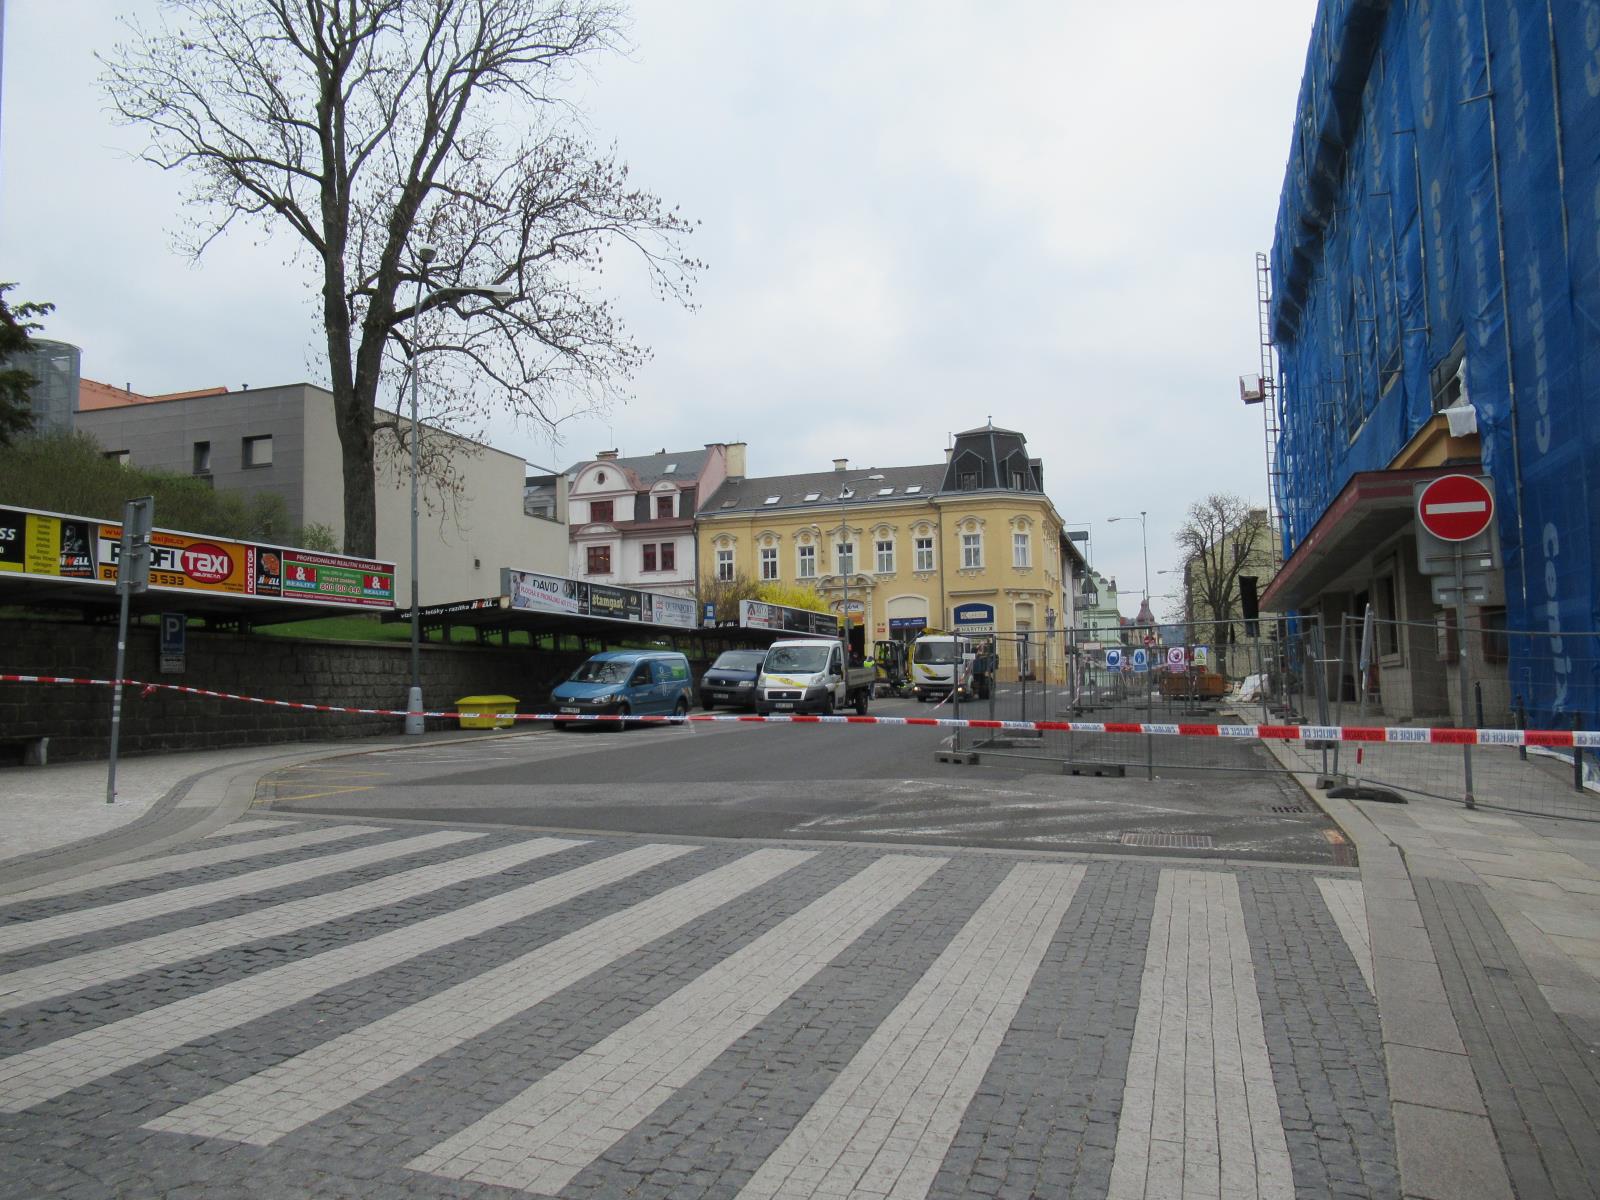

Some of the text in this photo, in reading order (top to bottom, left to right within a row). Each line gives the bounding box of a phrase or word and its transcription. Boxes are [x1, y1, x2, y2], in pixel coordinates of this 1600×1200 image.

[159, 574, 185, 585] 533
[286, 579, 317, 589] REALITY
[533, 579, 559, 593] DAVID
[364, 588, 390, 596] REALITY
[166, 617, 180, 641] P
